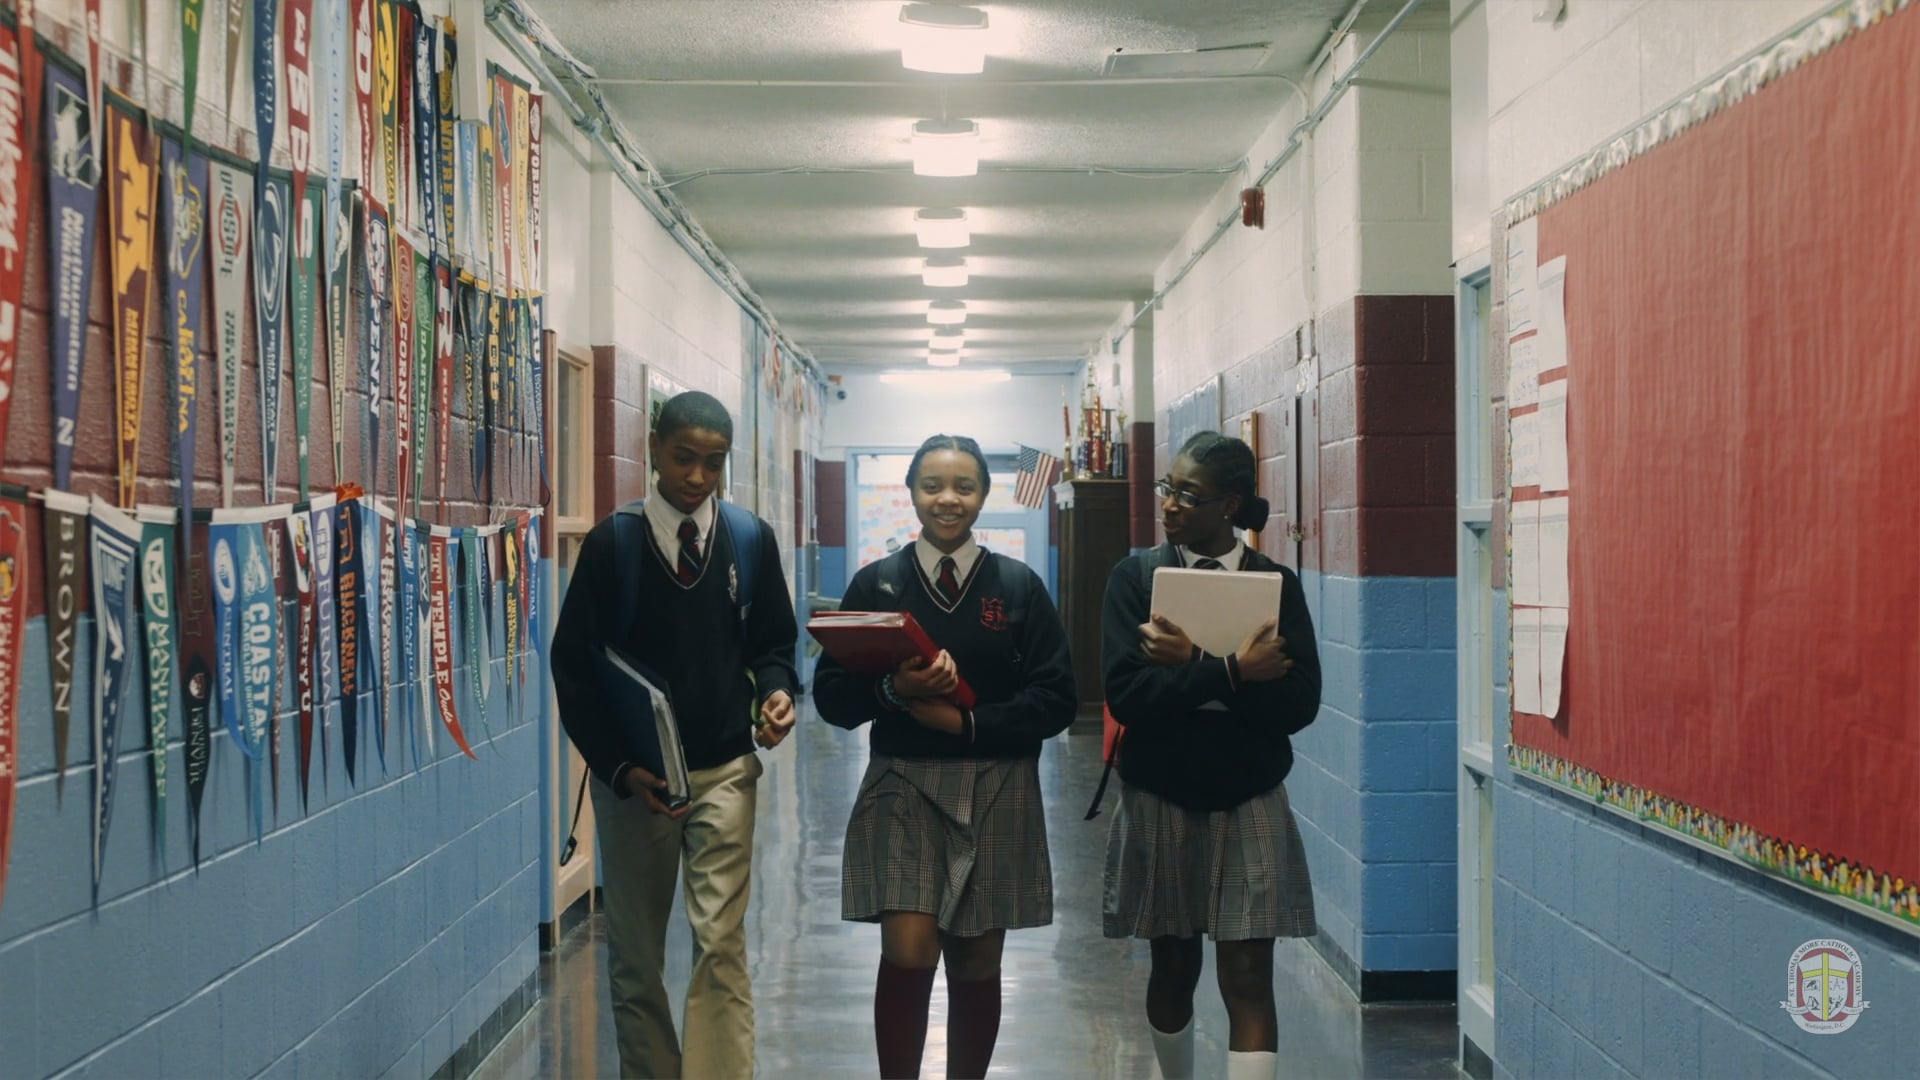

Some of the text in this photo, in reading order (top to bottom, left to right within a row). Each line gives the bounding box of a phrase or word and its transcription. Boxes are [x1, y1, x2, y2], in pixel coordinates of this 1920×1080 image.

[422, 121, 435, 253] COUGARS
[441, 119, 453, 196] NOTRE
[485, 161, 494, 254] MICHIGAN
[530, 142, 541, 241] FORDHAM
[123, 308, 139, 441] MINNESOTA
[369, 294, 382, 419] PENN
[397, 321, 410, 457] CORNELL
[416, 328, 429, 476] DARTMOUTH
[58, 416, 75, 447] N
[54, 516, 76, 713] BROWN
[341, 570, 356, 696] BUCKNELL
[420, 543, 431, 602] GW
[222, 606, 234, 702] CENTRAL
[243, 610, 258, 747] CAROLINA UNIVERSITY
[247, 602, 271, 745] COASTAL
[318, 576, 332, 728] FURMAN
[431, 591, 449, 685] TEMPLE
[156, 622, 170, 798] MANHATTAN
[439, 687, 454, 724] Owls
